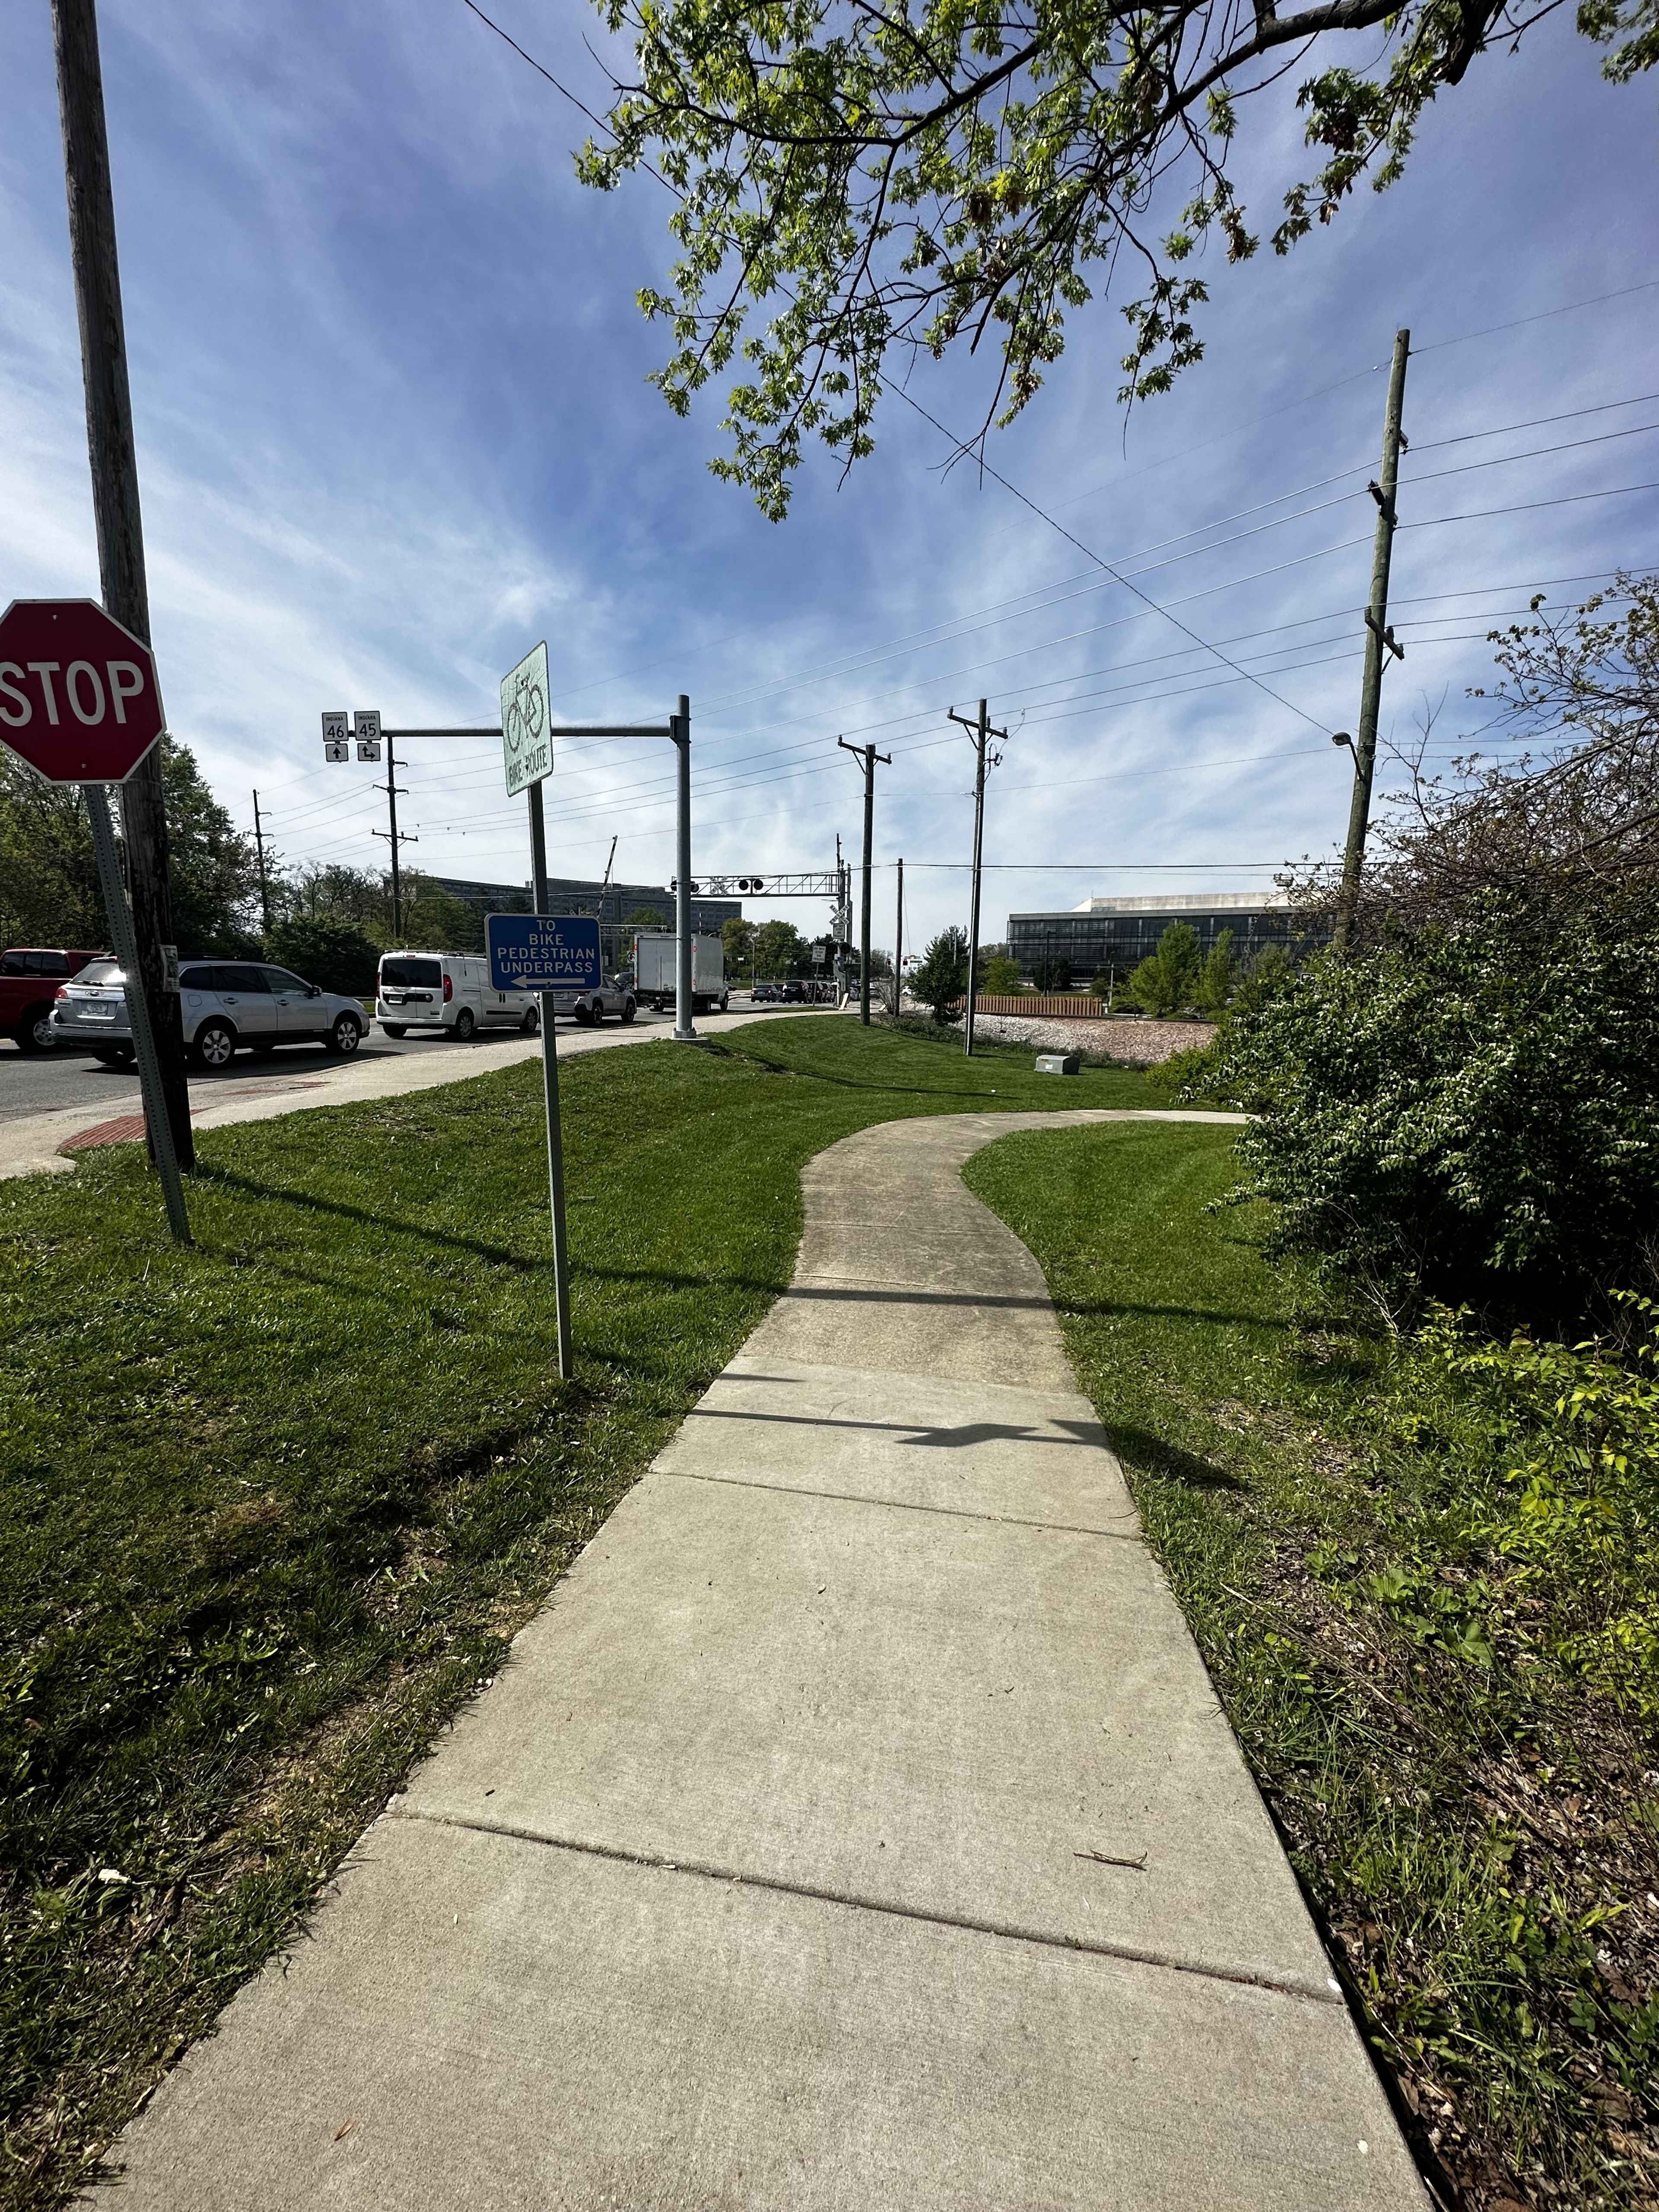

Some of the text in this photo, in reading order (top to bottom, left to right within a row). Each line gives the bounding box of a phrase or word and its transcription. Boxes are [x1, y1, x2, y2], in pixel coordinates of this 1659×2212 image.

[0, 661, 144, 727] STOP
[327, 725, 344, 738] 46
[359, 723, 376, 736] 45
[509, 743, 547, 787] BIKE ROUTE
[537, 920, 556, 931] TO
[529, 934, 564, 945] BIKE
[498, 947, 594, 959] PEDESTRIAN
[501, 962, 593, 973] UNDERPASS
